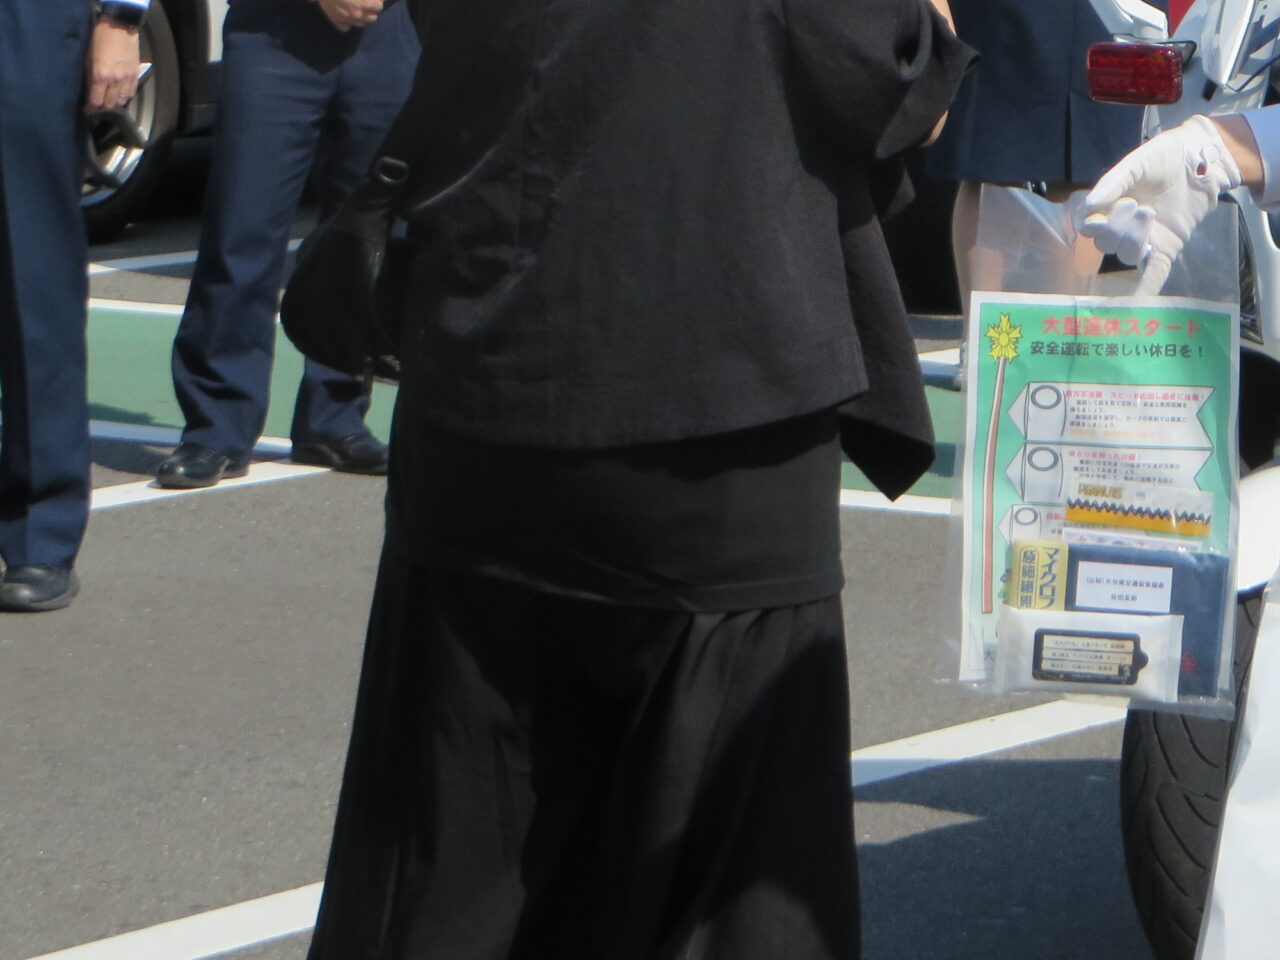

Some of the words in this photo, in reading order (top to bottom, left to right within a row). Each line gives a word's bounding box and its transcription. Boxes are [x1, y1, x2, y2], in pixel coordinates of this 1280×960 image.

[1041, 314, 1202, 338] 大型連休スタート
